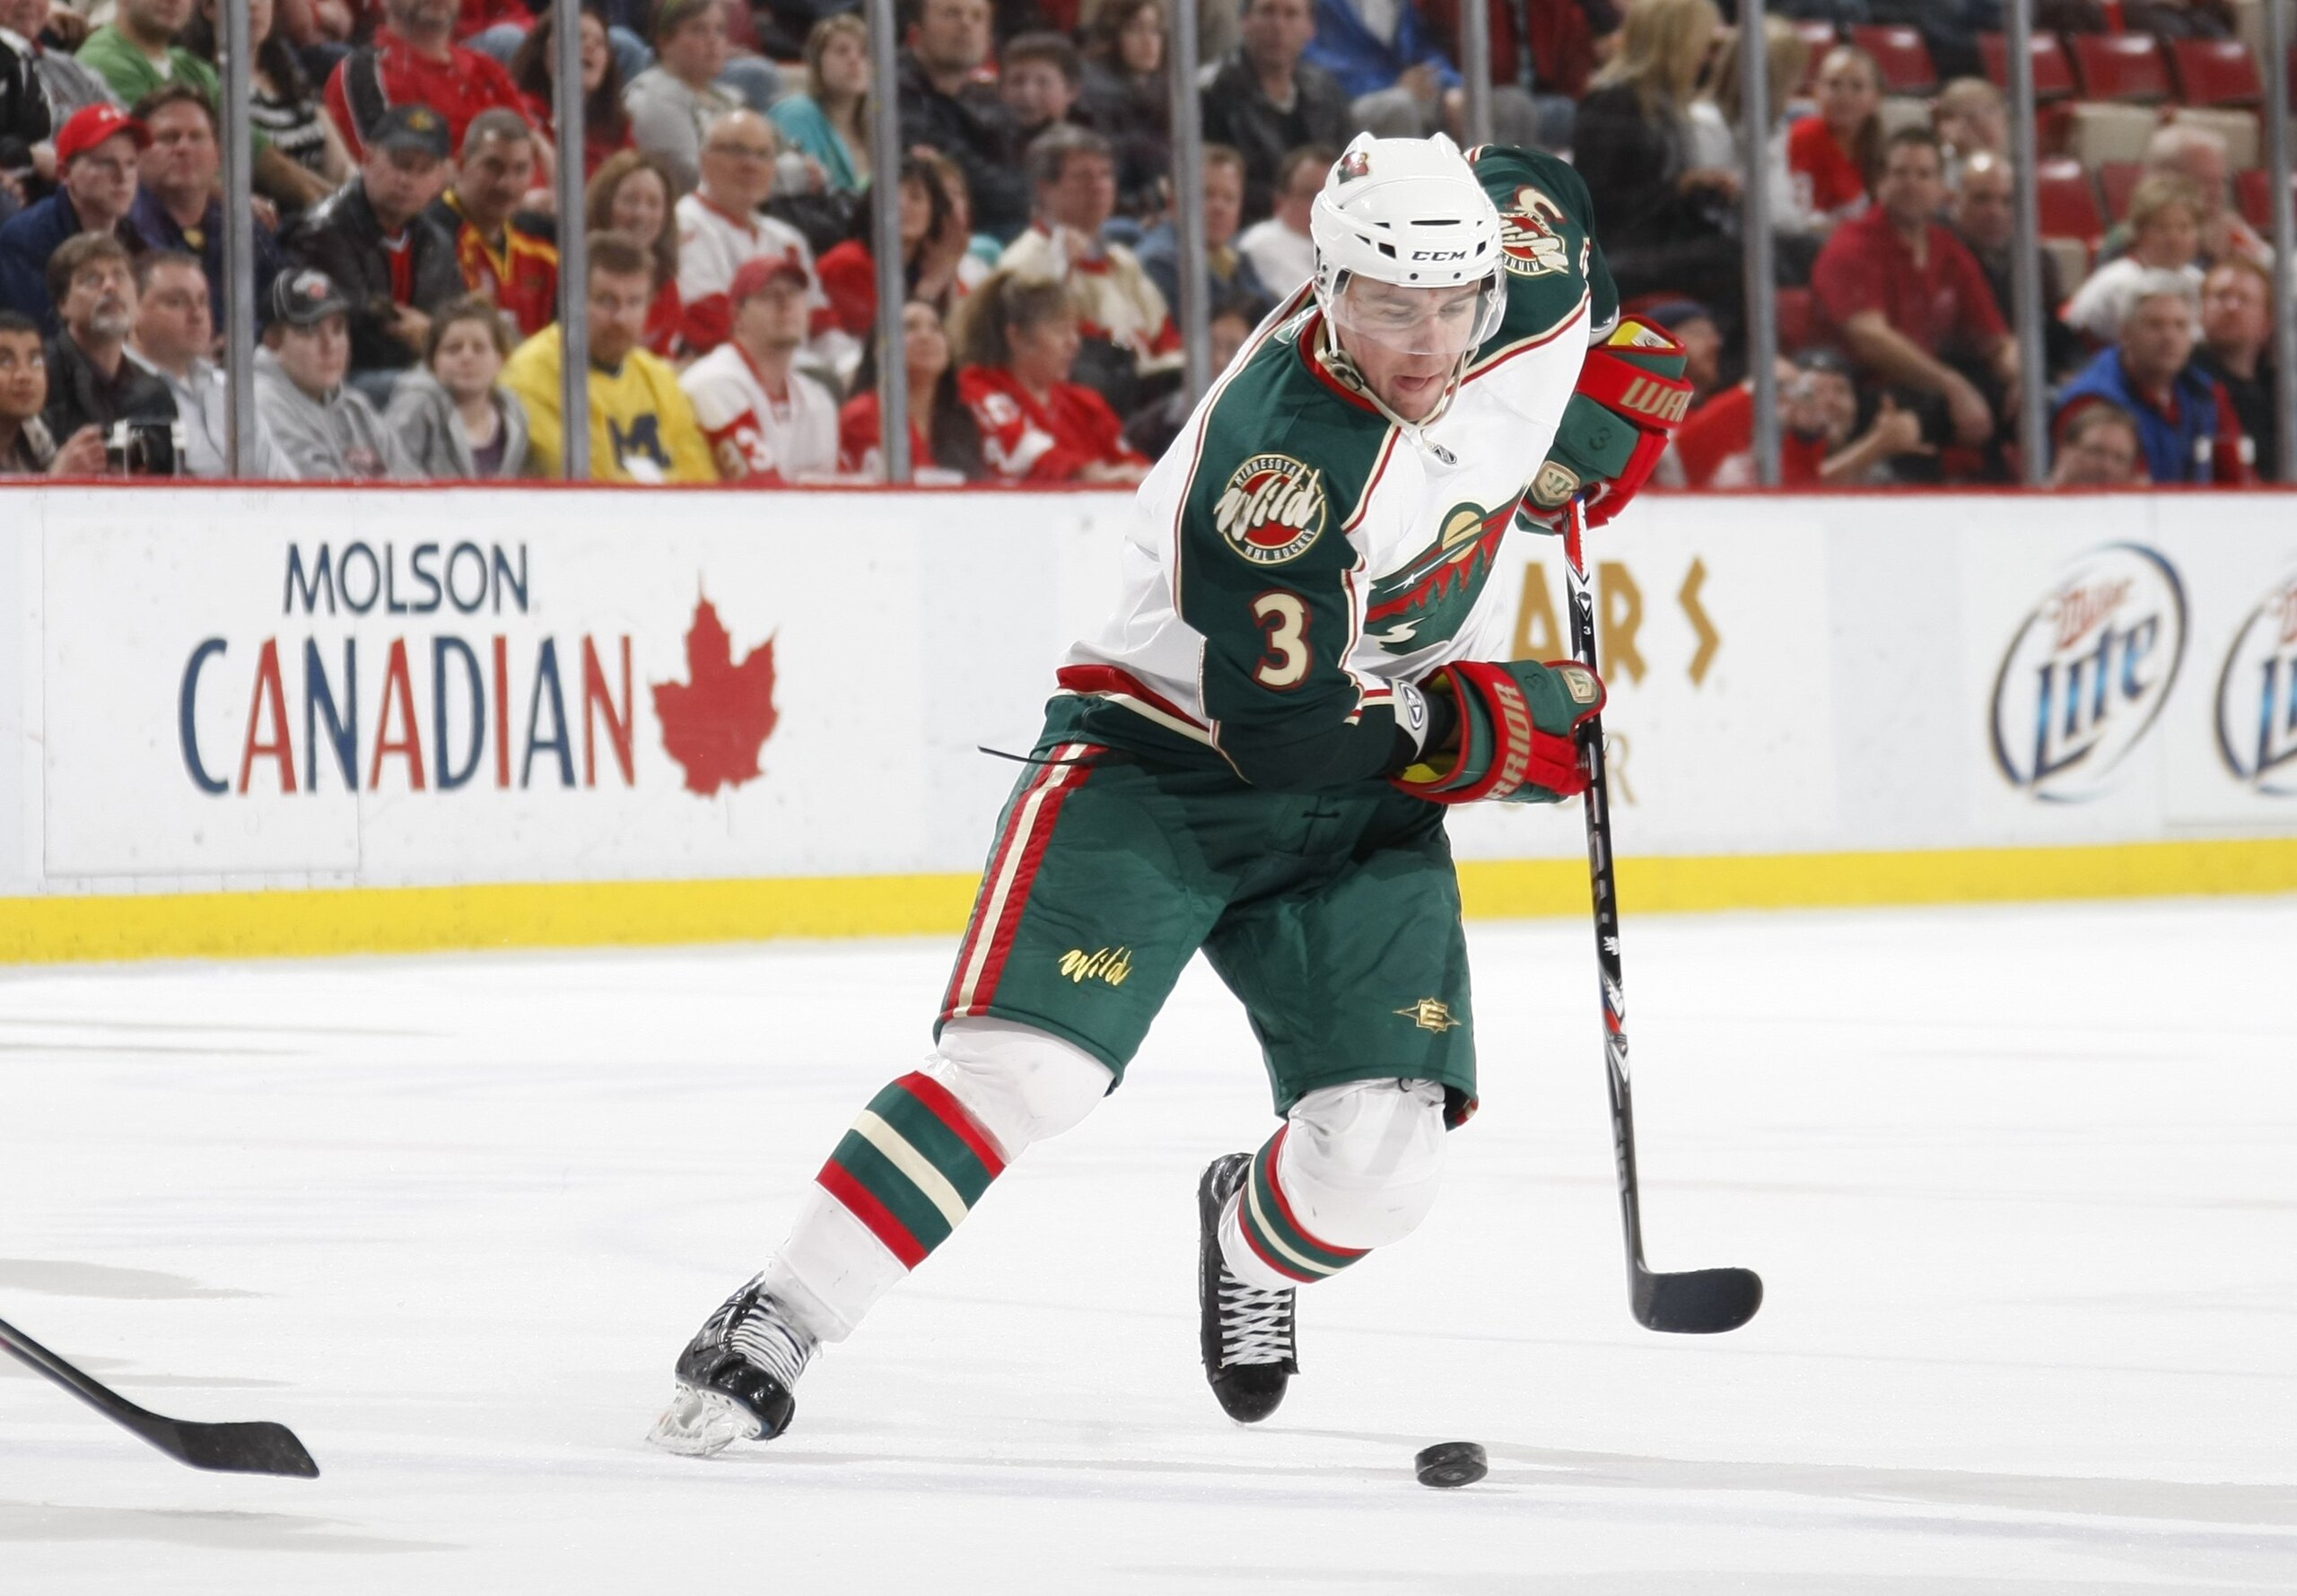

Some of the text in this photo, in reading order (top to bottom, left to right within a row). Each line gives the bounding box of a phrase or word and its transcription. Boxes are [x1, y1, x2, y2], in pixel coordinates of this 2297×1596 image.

[1411, 250, 1468, 261] CCM
[1503, 254, 1540, 272] MINNE
[608, 413, 671, 469] M
[1234, 458, 1297, 486] MINNESOTA
[1213, 463, 1325, 541] Wild
[1245, 528, 1316, 561] NHL HOCKEY
[284, 541, 528, 616] MOLSON
[1250, 589, 1313, 691] 3
[1511, 552, 1720, 687] ARS
[1583, 625, 1592, 635] 3
[179, 634, 635, 797] CANADIAN
[2030, 614, 2159, 783] Lite
[1485, 682, 1531, 800] RRIOR
[1058, 946, 1133, 986] Wild
